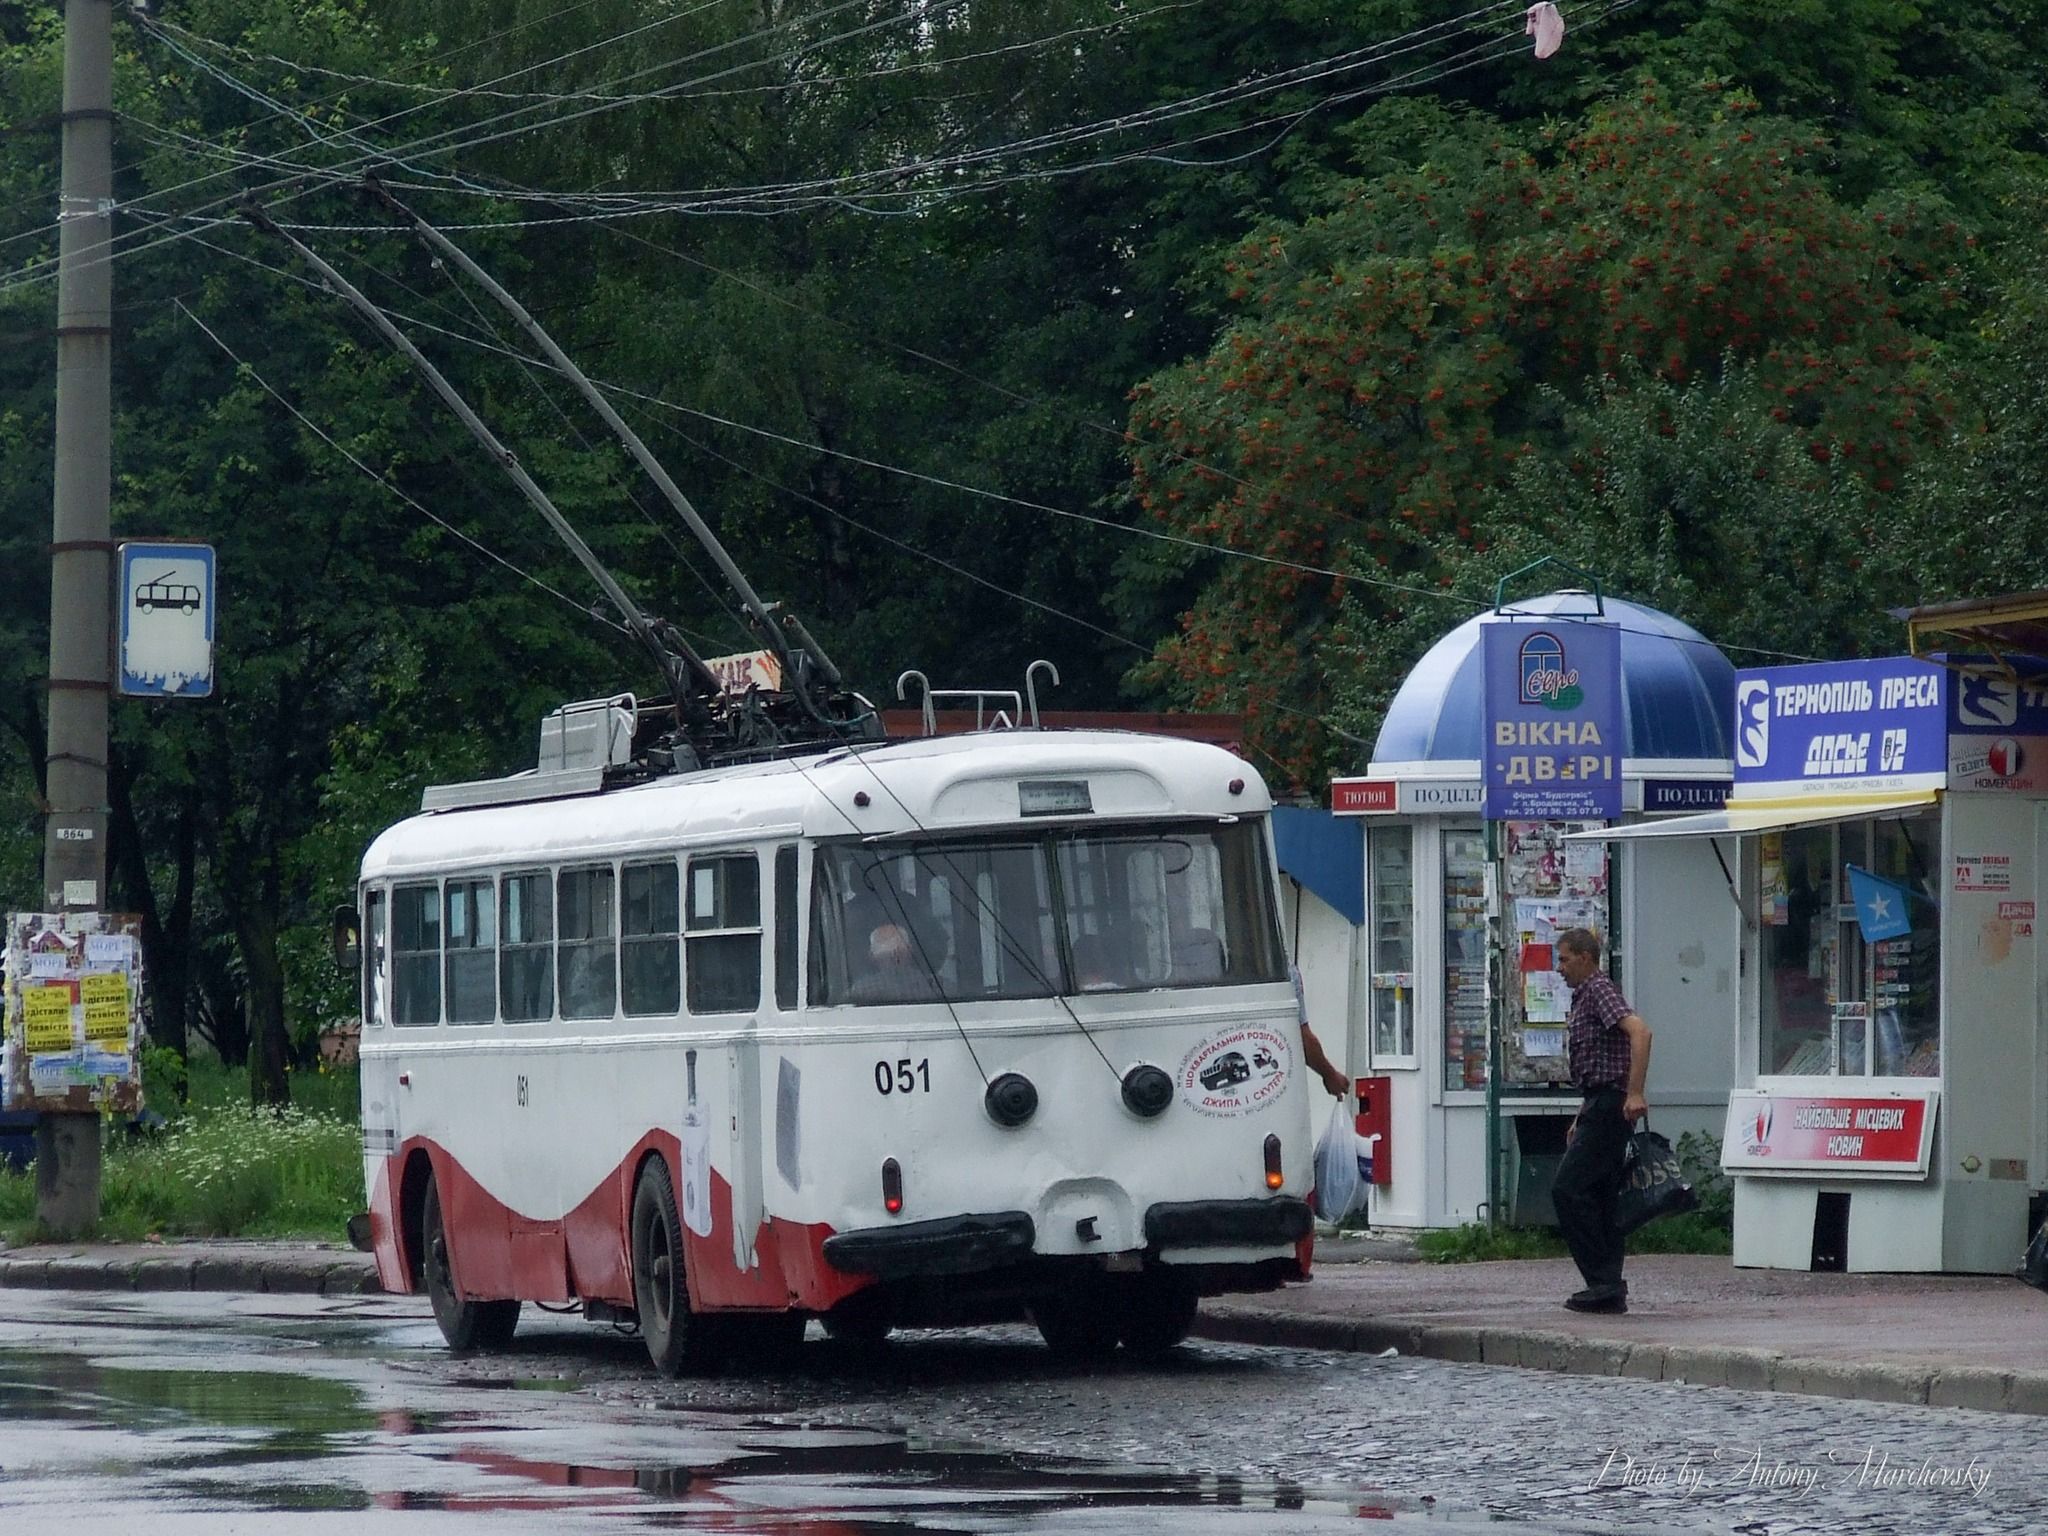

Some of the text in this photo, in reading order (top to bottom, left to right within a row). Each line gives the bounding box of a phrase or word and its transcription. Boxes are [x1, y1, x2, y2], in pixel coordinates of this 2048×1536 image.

[1775, 675, 1939, 717] ТЕРНОПІЛЬ ПРЕСА
[1496, 721, 1602, 745] ВІКНА
[1343, 790, 1387, 805] ТЮТЮН
[516, 1074, 529, 1107] 051
[875, 1057, 930, 1096] 051
[1201, 1096, 1242, 1108] ДЖИПА
[1253, 1070, 1285, 1101] СКУТЕРА
[1794, 1103, 1906, 1133] НАЙБІЛЬШЕ МІСЦЕВИХ
[1827, 1135, 1864, 1157] НОВИН
